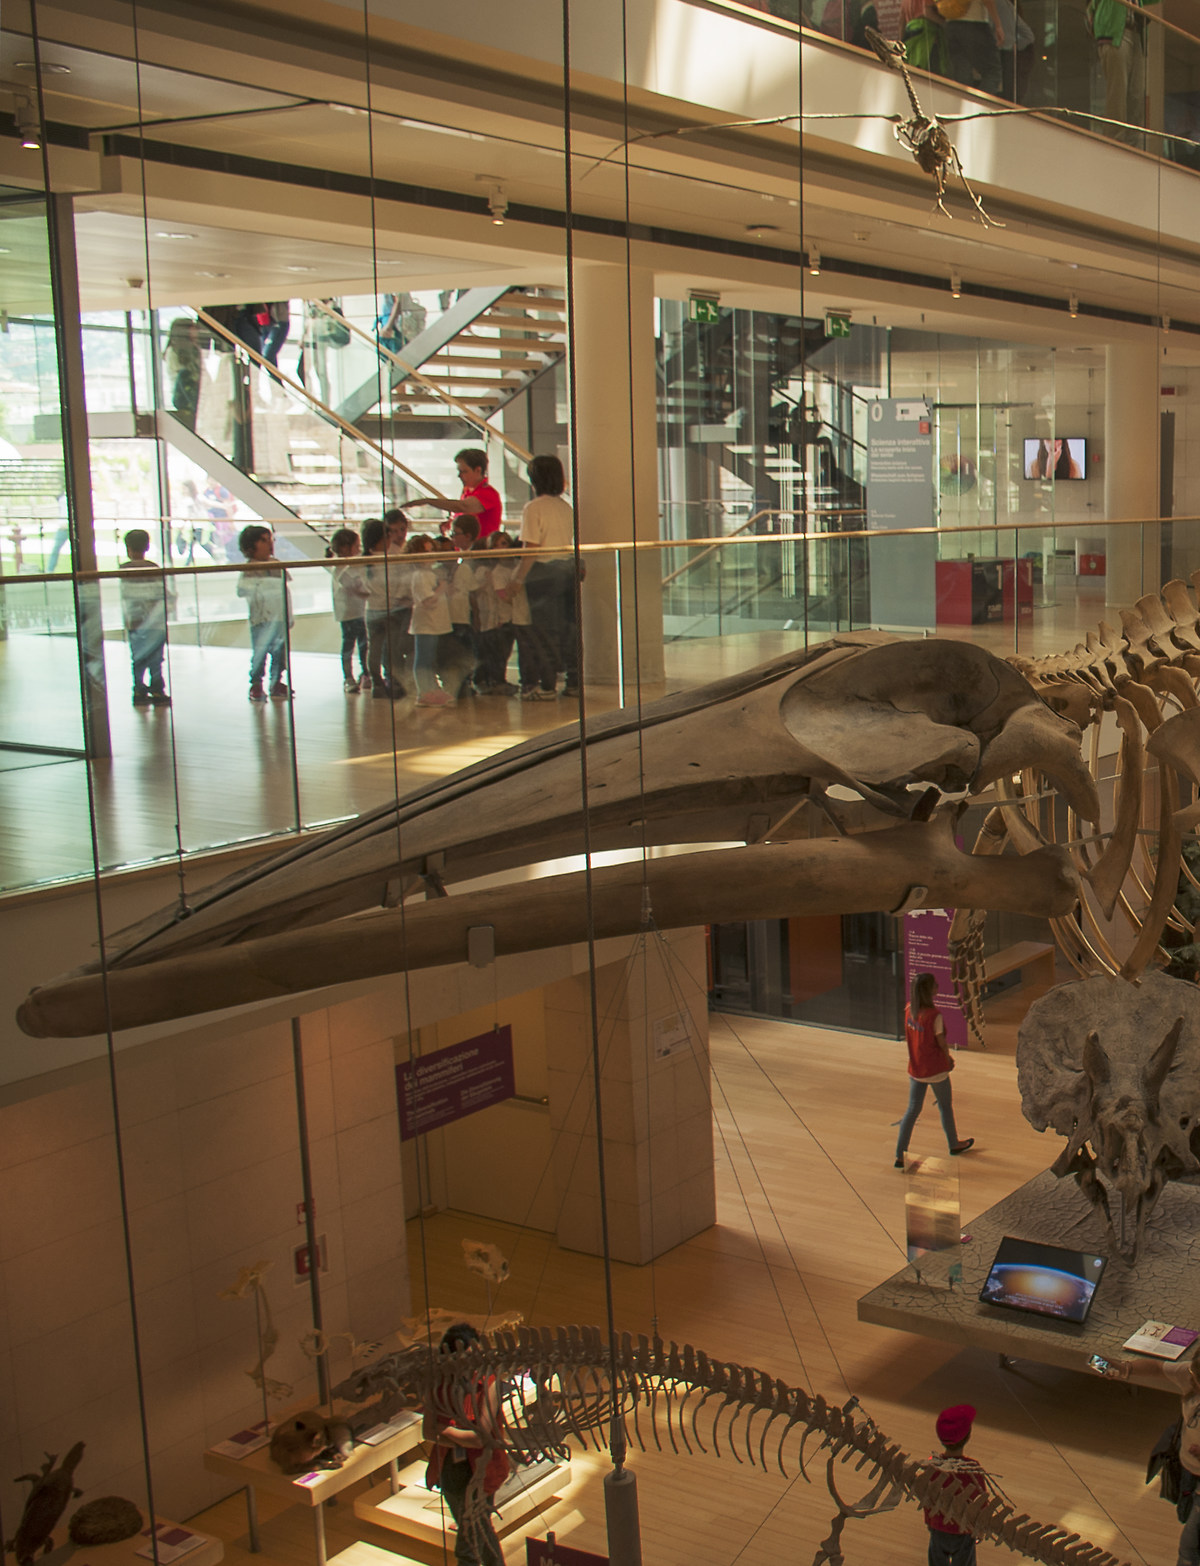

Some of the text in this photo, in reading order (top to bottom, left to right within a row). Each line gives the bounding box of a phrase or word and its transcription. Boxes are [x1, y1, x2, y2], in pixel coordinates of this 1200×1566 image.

[871, 403, 883, 422] 0
[416, 1049, 479, 1077] diversificazione
[419, 1062, 464, 1085] mammiferi
